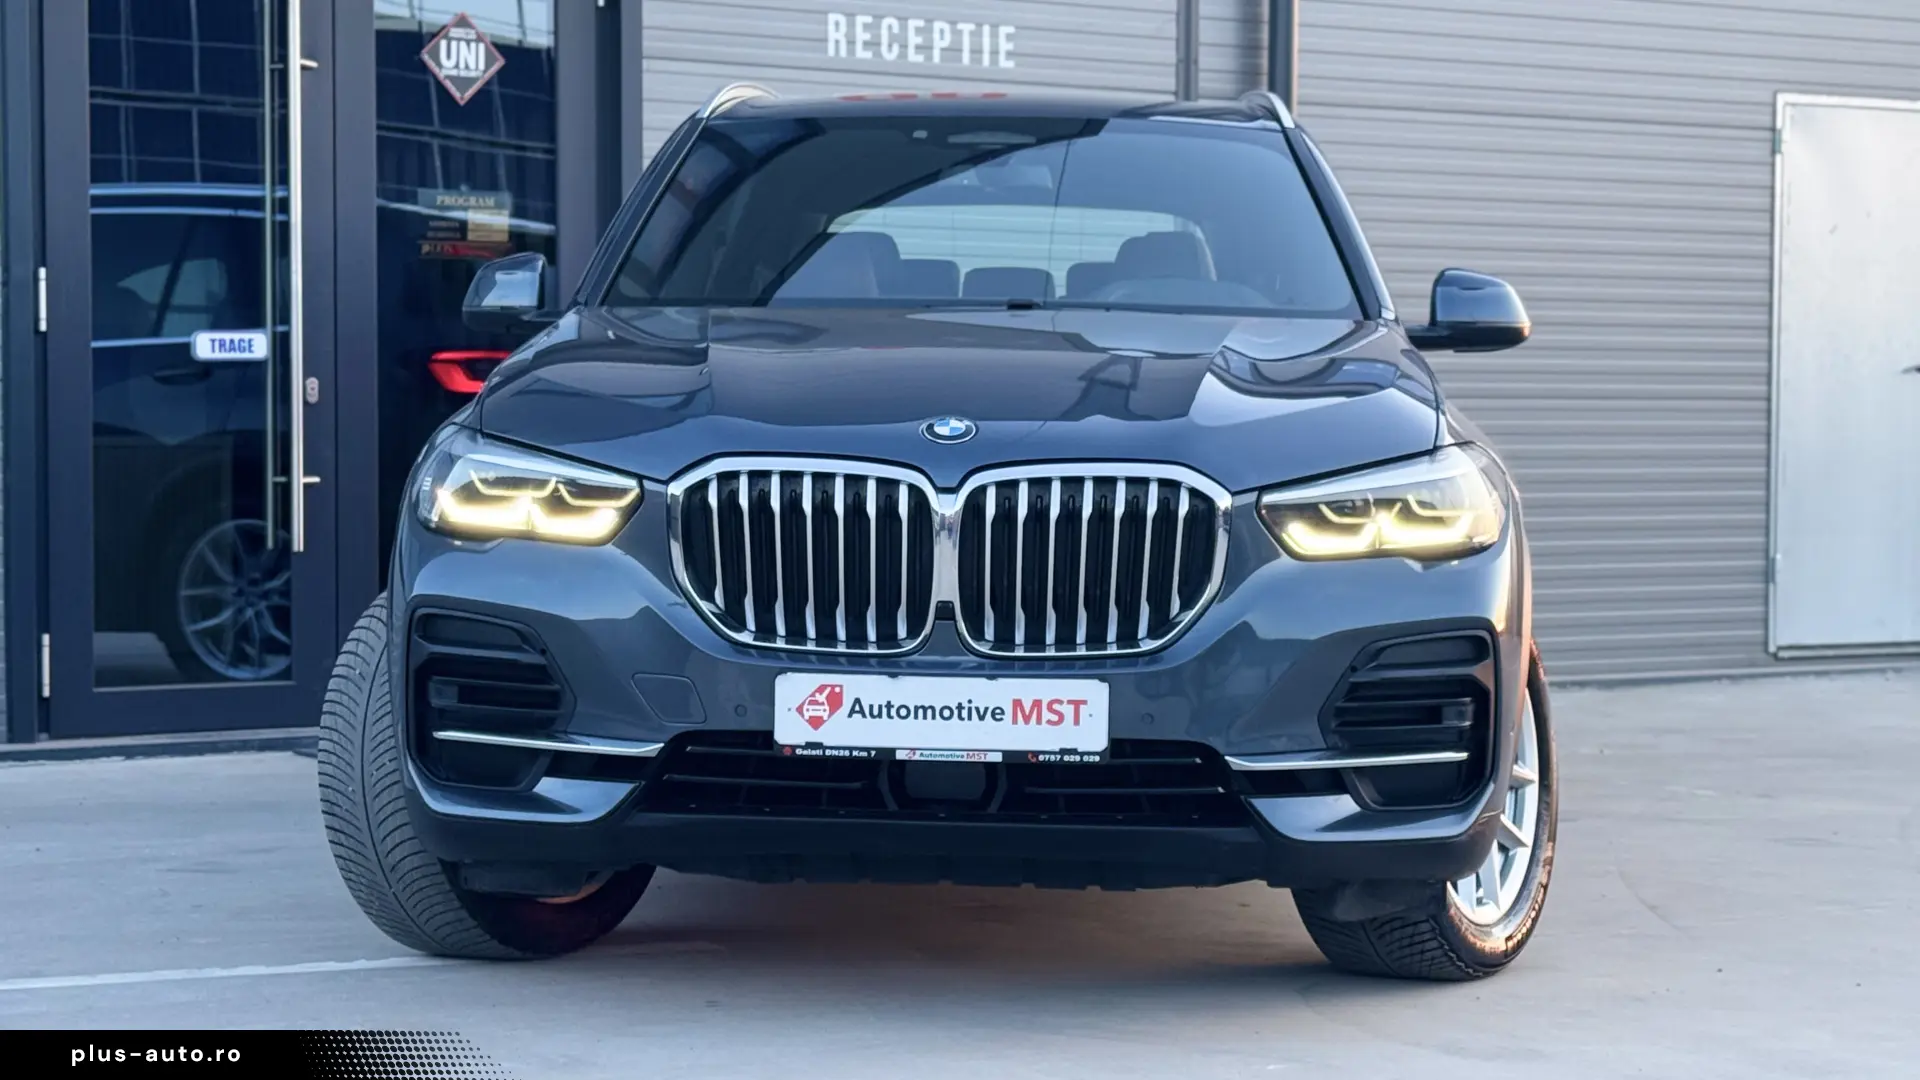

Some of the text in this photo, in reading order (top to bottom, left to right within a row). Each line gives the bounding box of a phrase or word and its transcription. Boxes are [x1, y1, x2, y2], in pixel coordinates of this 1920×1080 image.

[827, 12, 1016, 68] RECEPTIE
[439, 39, 486, 71] UNI
[435, 195, 495, 207] PROGRAM
[209, 338, 255, 354] TRAGE
[847, 697, 1088, 727] Automotive MST
[870, 750, 876, 758] 7
[919, 752, 989, 761] Automotive MST
